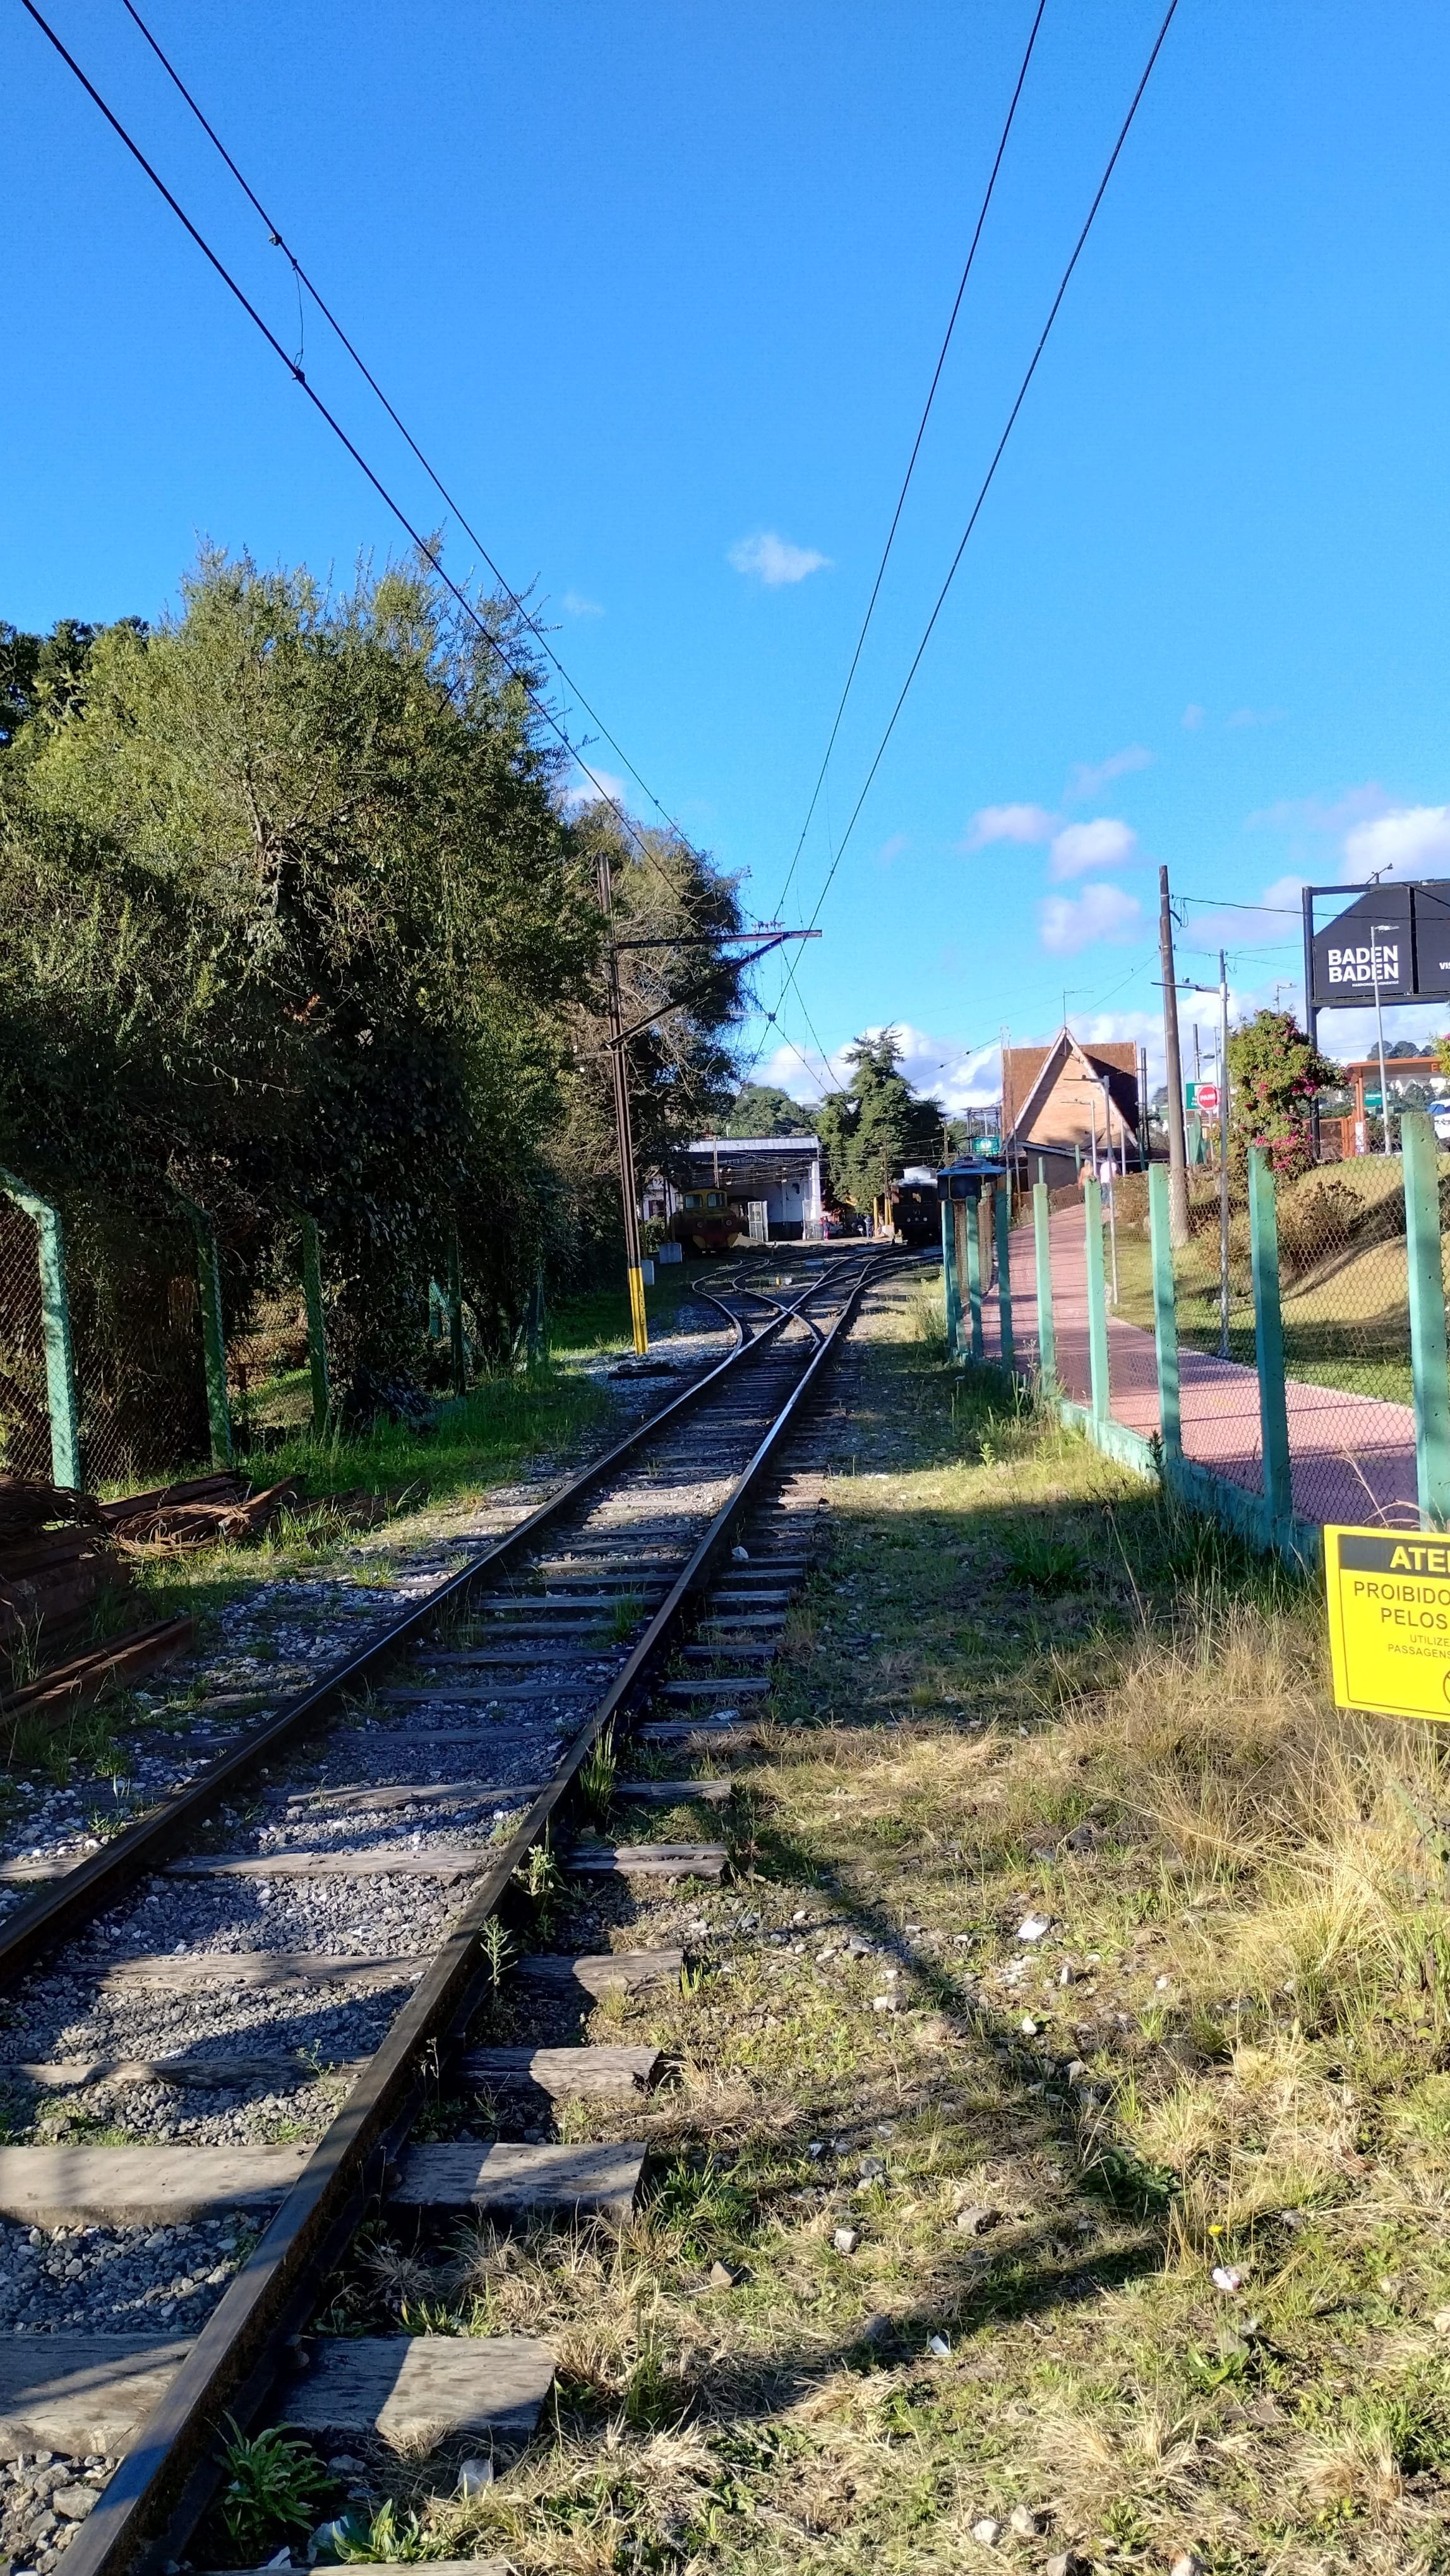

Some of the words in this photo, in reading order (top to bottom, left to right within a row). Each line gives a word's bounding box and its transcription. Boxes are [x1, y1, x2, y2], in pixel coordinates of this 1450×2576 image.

[1328, 945, 1398, 966] BADEN
[1329, 963, 1399, 982] BADEN
[1390, 1546, 1450, 1573] ATE
[1353, 1580, 1450, 1605] PROIBIDO
[1381, 1607, 1448, 1630] PELOS
[1410, 1634, 1450, 1647] UTILIZE
